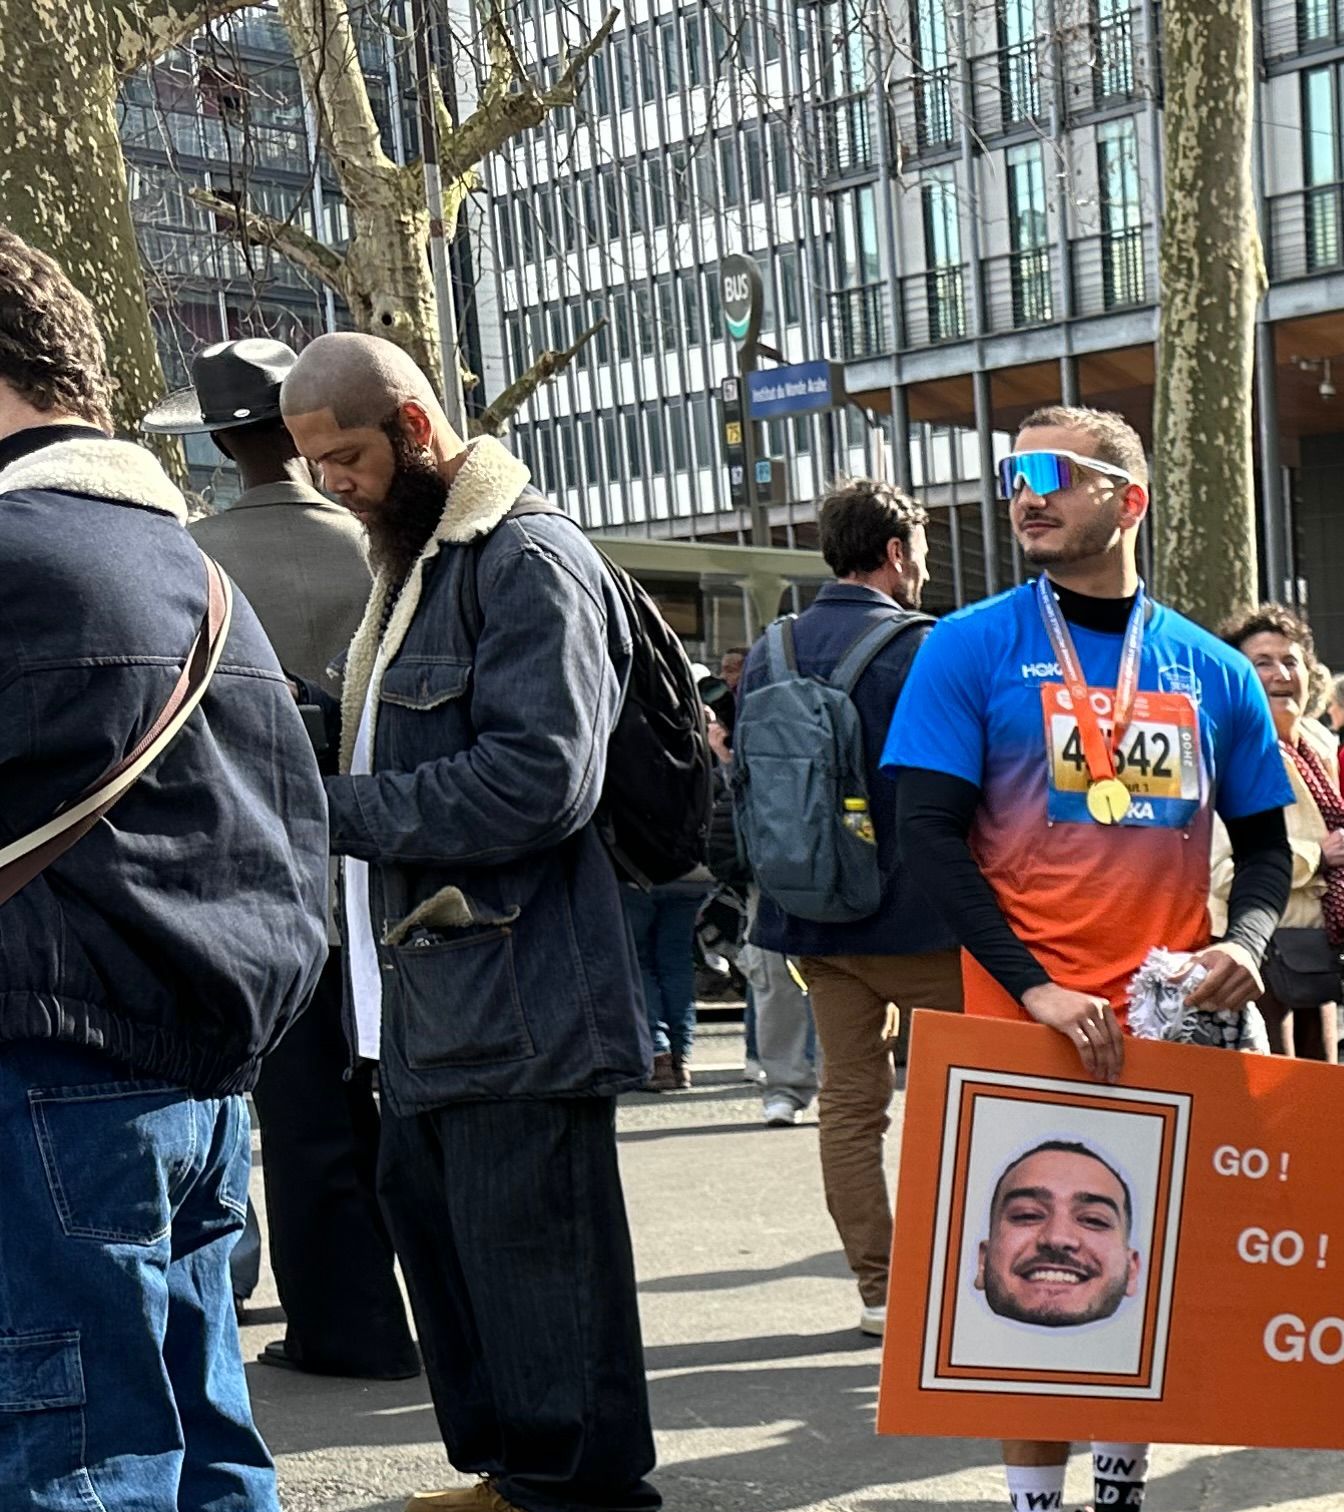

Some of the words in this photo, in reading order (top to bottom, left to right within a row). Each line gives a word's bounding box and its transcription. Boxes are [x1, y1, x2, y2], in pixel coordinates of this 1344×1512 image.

[723, 273, 749, 303] BUS
[1022, 662, 1064, 678] HOK
[1128, 802, 1155, 819] KA
[1212, 1144, 1270, 1179] GO
[1279, 1152, 1290, 1182] !
[1236, 1226, 1305, 1267] GO
[1316, 1233, 1329, 1269] !
